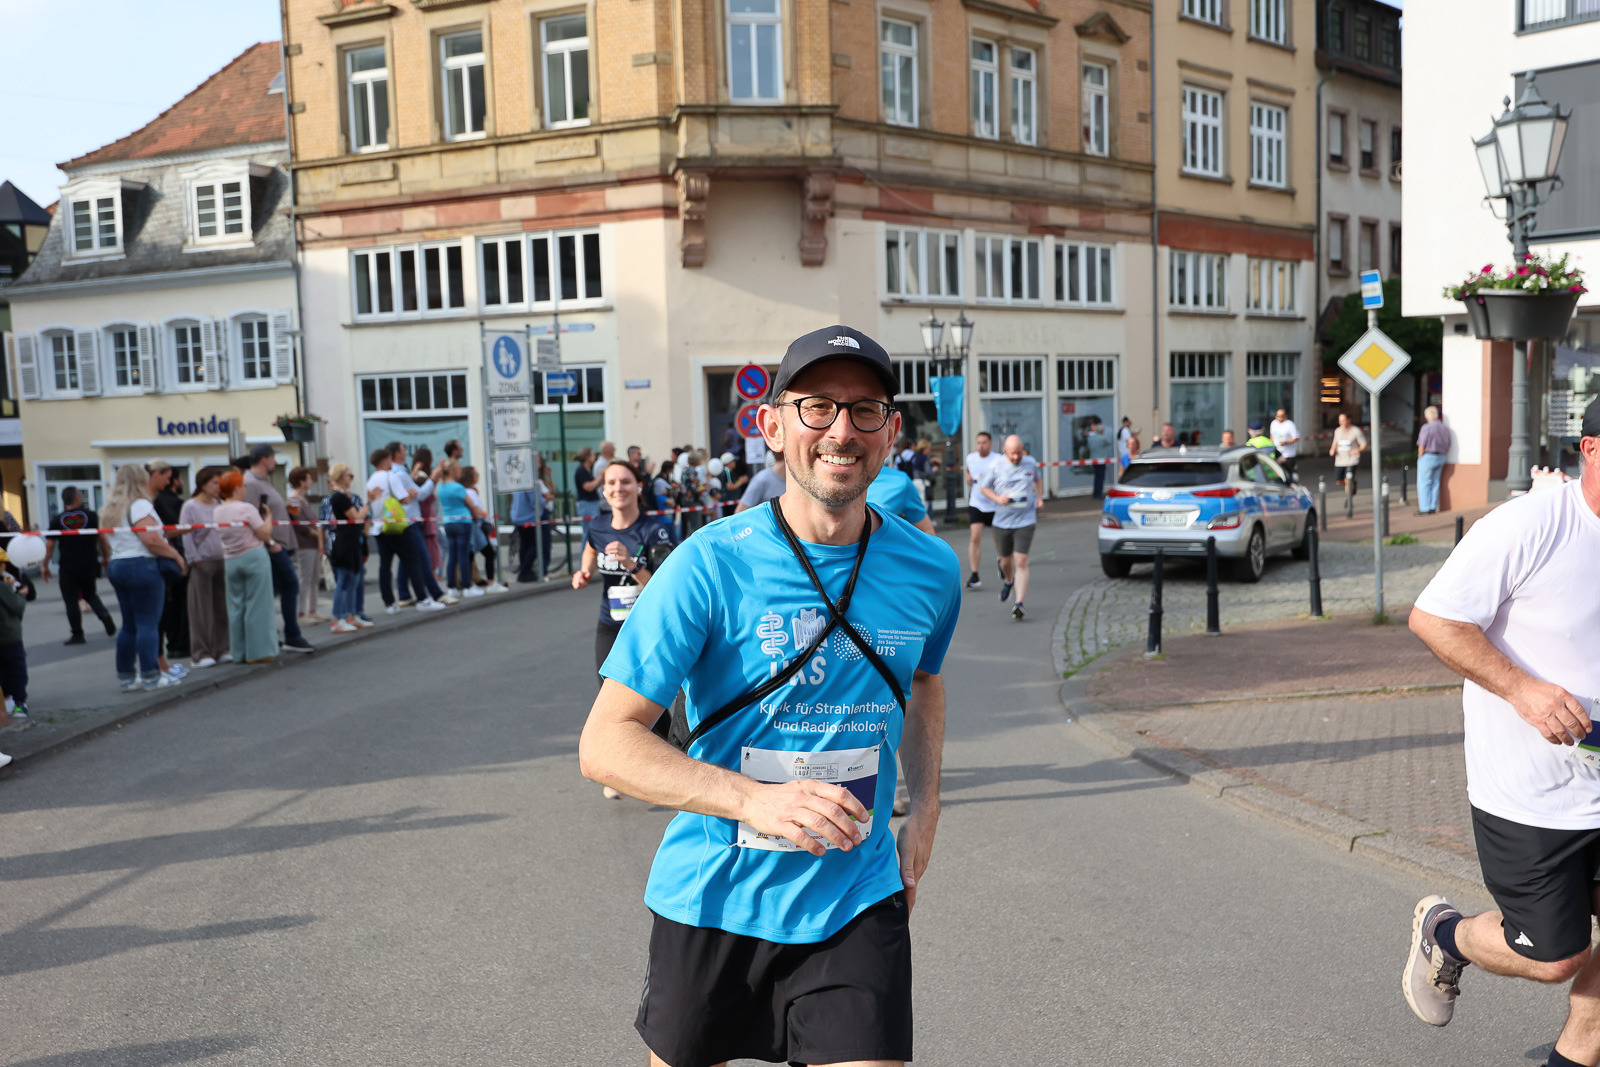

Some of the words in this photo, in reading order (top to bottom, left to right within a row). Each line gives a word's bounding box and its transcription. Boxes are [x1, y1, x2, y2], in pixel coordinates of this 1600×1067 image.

[499, 382, 521, 393] ZONE
[875, 645, 896, 657] UTS
[795, 702, 813, 715] für
[773, 720, 799, 732] und
